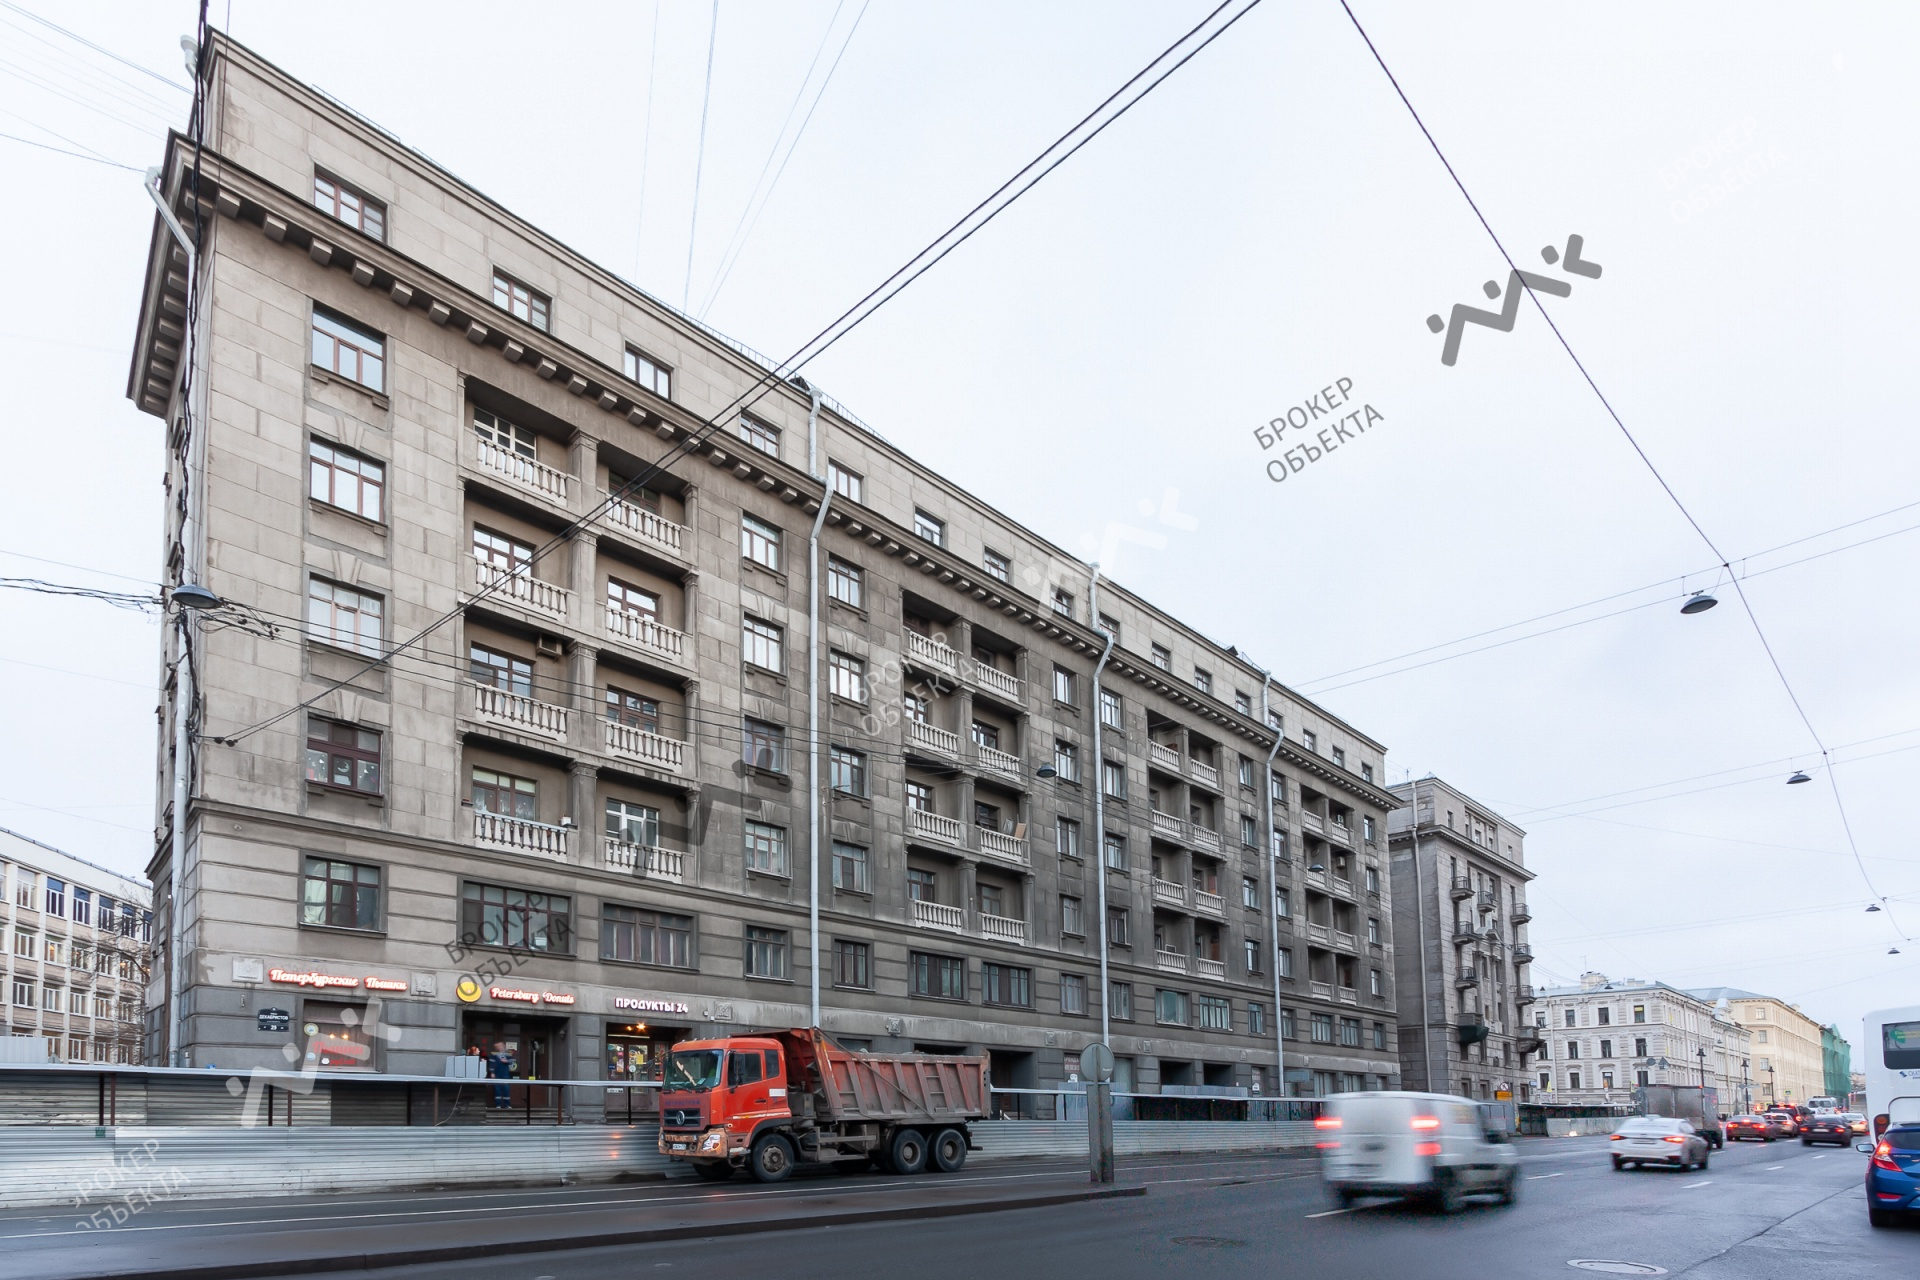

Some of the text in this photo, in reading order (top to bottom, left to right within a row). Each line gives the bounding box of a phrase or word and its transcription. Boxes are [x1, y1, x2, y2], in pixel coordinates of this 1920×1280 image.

[269, 968, 408, 991] Петербургские Пышки
[490, 987, 575, 1005] Petersburg Donuts
[615, 997, 689, 1014] ПРОДУКТЫ 24
